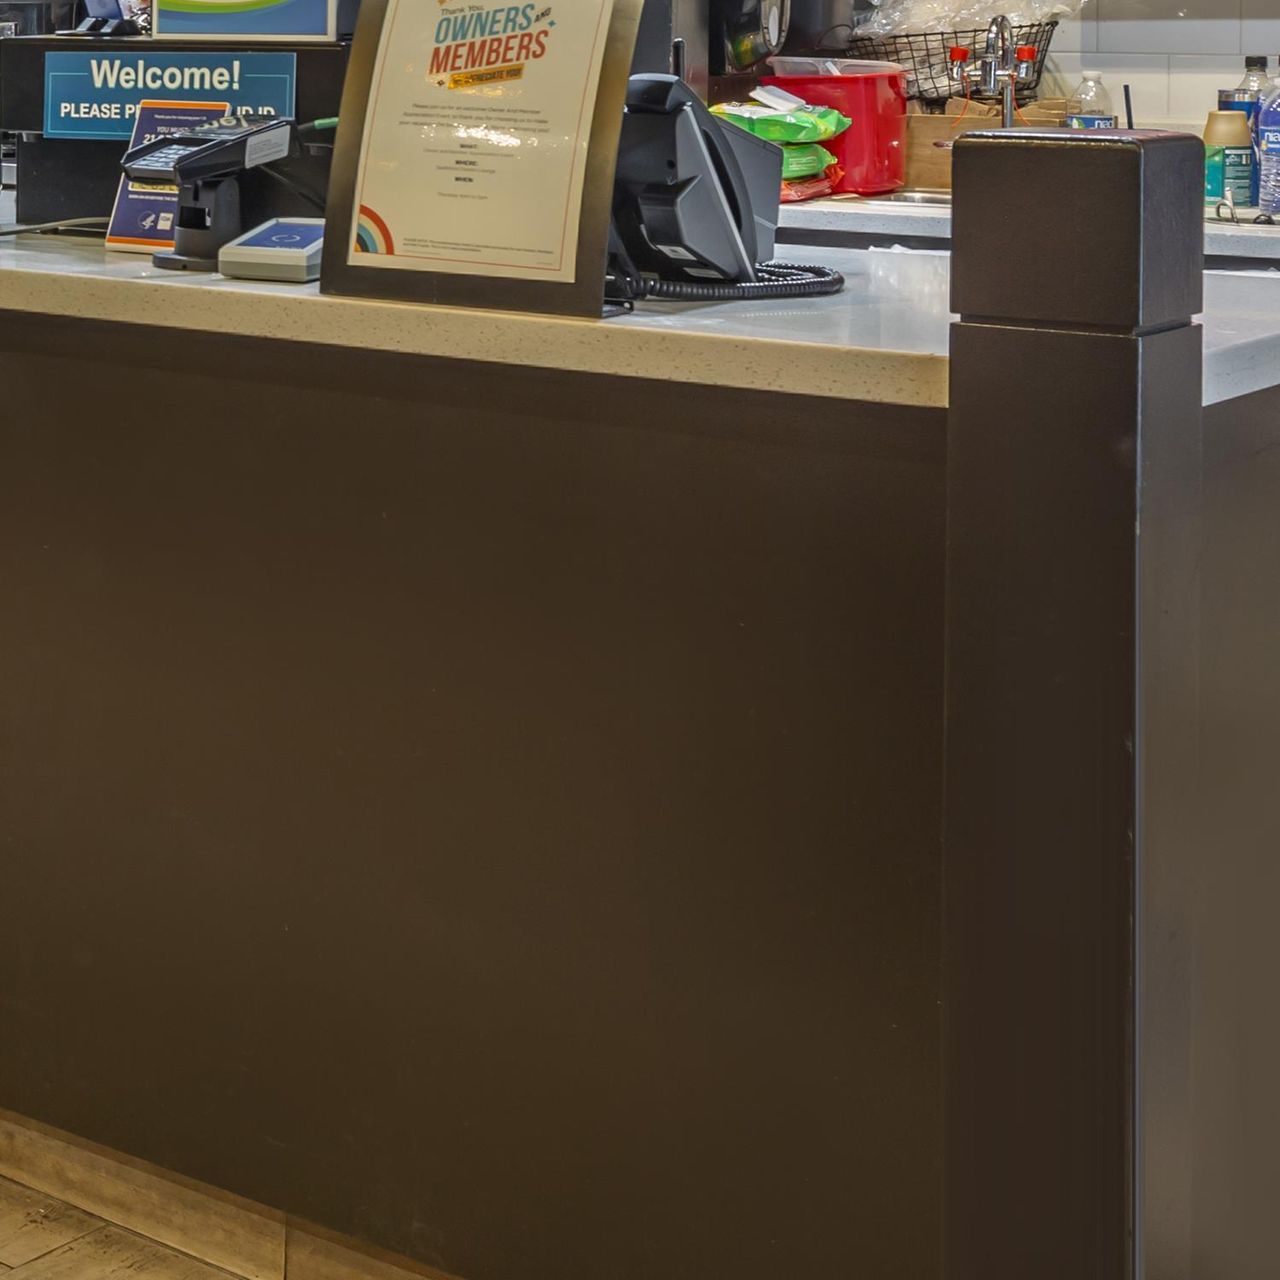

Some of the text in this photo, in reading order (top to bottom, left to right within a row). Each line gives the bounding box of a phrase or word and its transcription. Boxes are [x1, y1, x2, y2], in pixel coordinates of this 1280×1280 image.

[434, 3, 552, 44] OWNERS AND
[428, 29, 549, 75] MEMBERS
[90, 59, 241, 90] Welcome!
[60, 102, 122, 119] PLEASE
